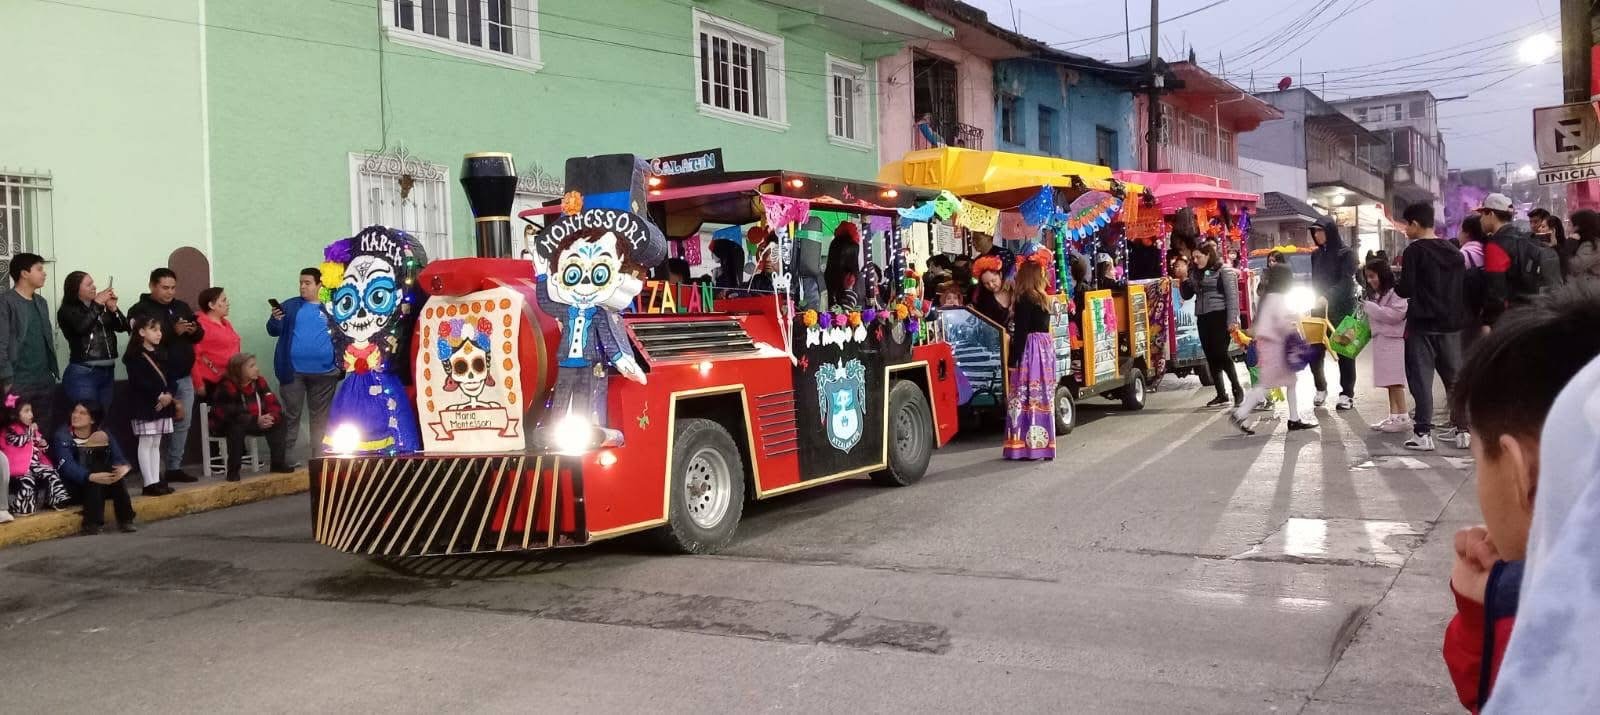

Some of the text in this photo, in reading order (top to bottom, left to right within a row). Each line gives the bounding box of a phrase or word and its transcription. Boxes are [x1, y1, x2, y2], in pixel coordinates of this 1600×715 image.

[1545, 168, 1597, 182] INICIA
[540, 208, 647, 254] MONTESSORI
[627, 280, 714, 315] ZALAN
